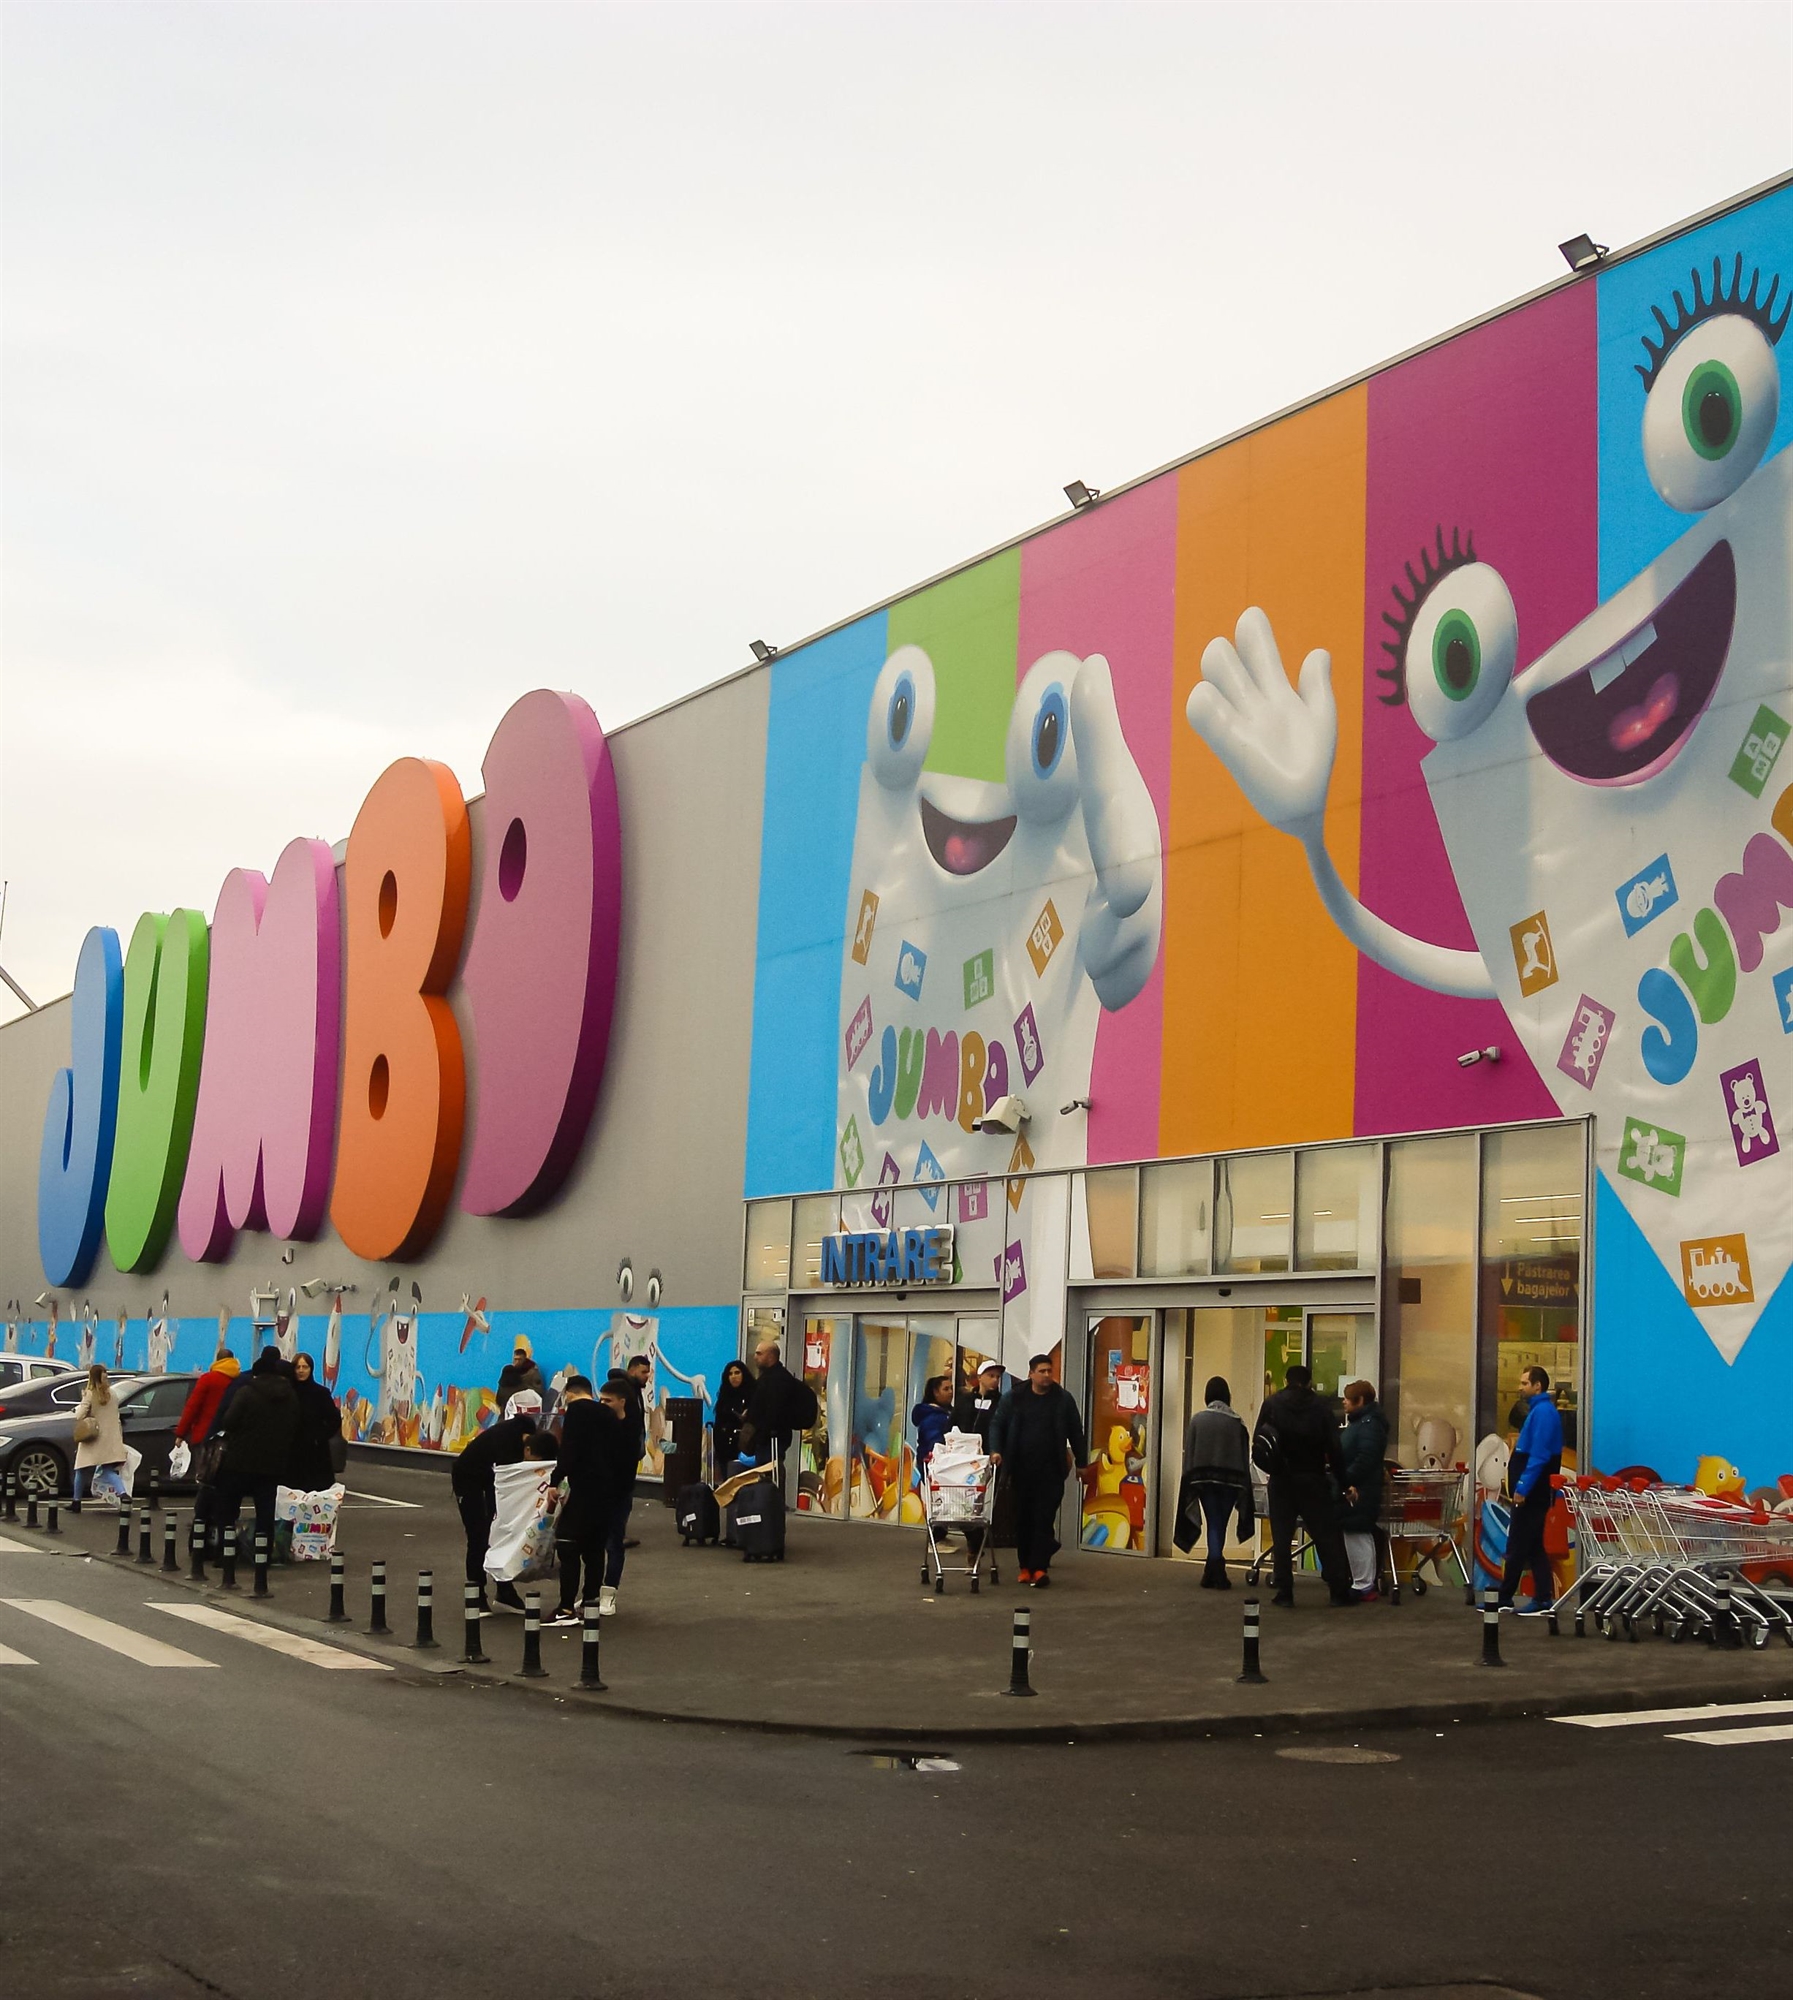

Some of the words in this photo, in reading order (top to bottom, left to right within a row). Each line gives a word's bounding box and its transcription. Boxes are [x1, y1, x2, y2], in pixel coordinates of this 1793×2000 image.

[38, 688, 621, 1288] JUMBO
[1637, 782, 1793, 1086] JUM
[820, 1228, 942, 1283] INTRARE
[1517, 1280, 1570, 1299] bagajelor
